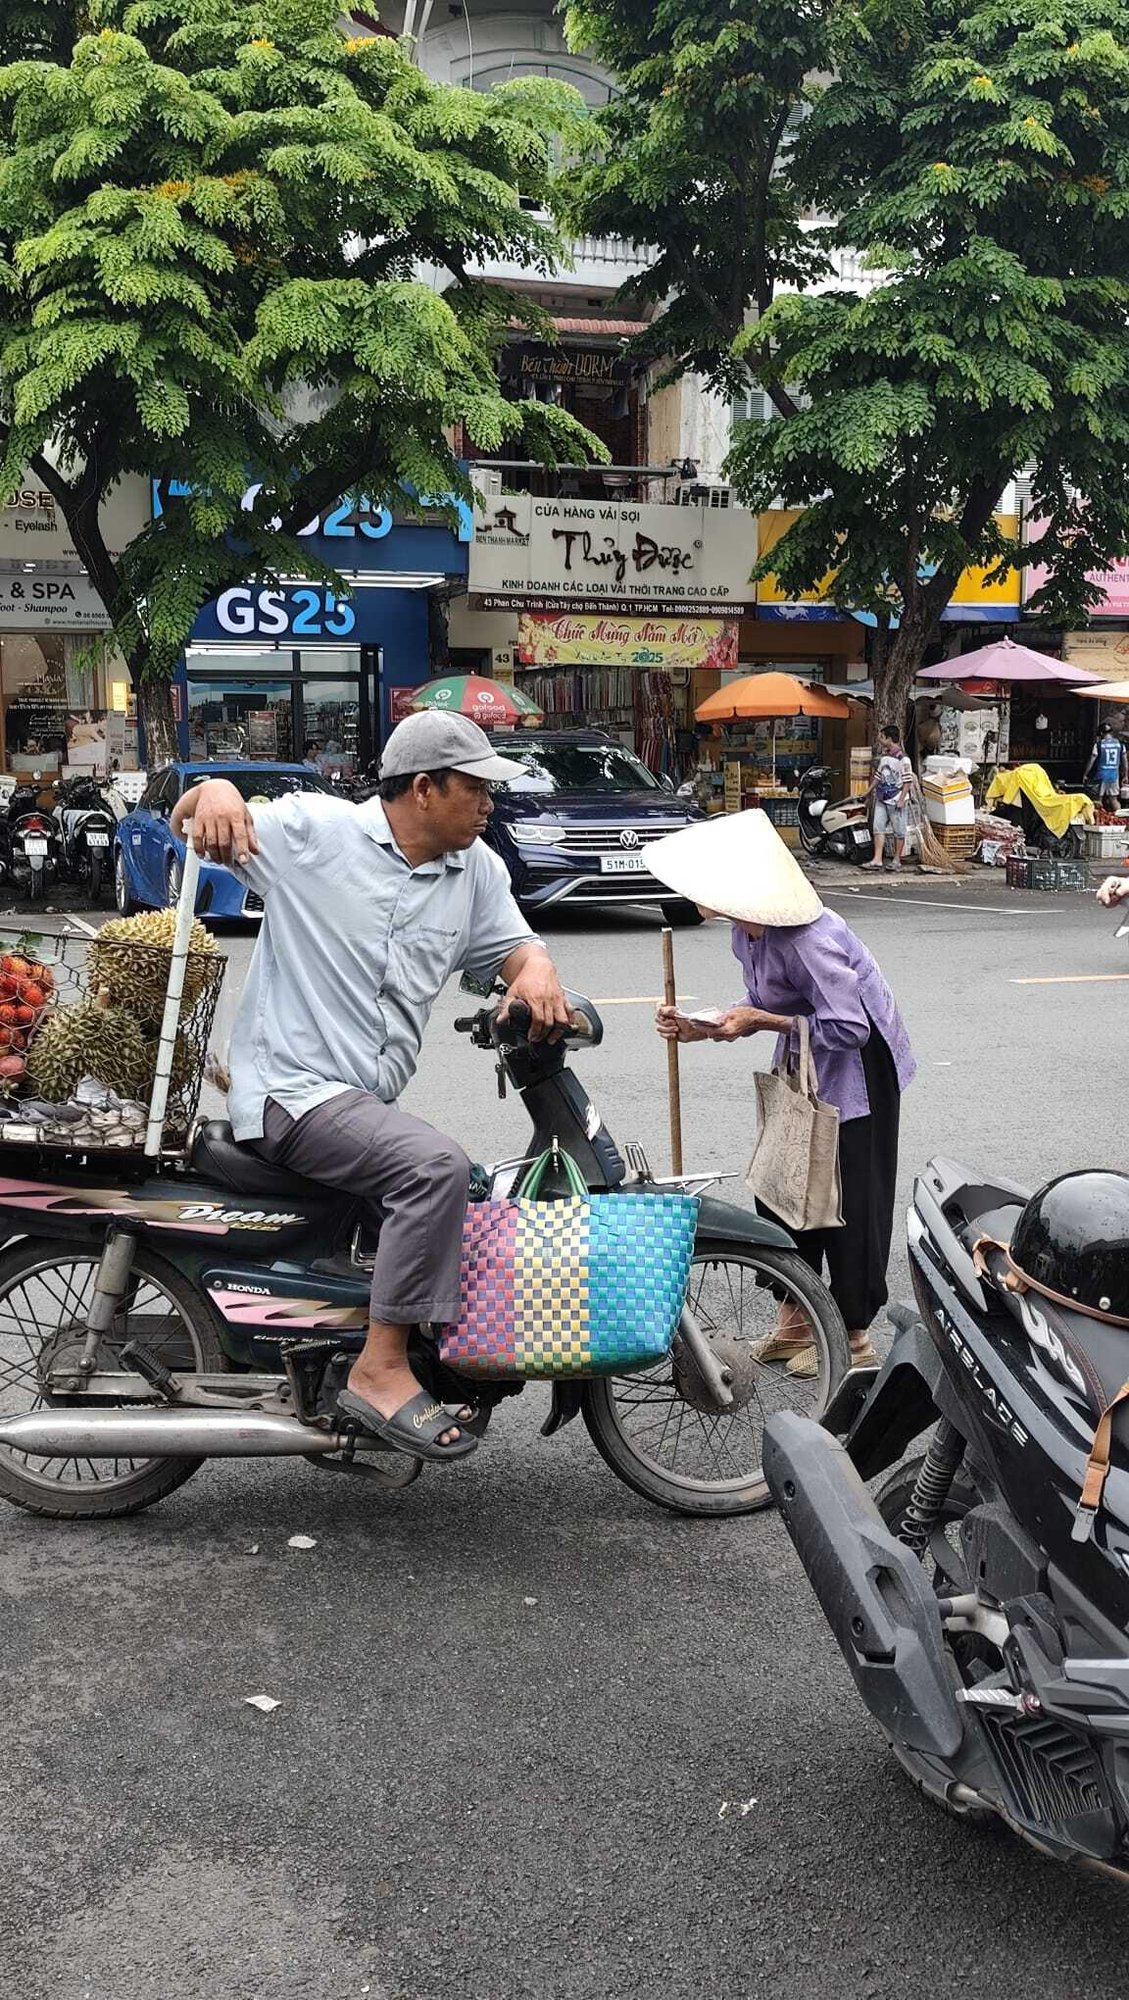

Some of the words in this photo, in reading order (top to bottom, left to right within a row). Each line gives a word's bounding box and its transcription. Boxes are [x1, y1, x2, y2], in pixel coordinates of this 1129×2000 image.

[241, 483, 394, 539] 25
[535, 503, 559, 517] CỬA
[563, 505, 595, 519] HÀNG
[599, 506, 617, 520] VẢI
[620, 510, 640, 524] SỢI
[15, 520, 58, 533] Eyelash
[552, 528, 628, 582] Thủy
[632, 531, 694, 575] Được
[10, 582, 25, 598] &
[32, 582, 76, 600] SPA
[502, 580, 524, 589] KINH
[526, 580, 560, 591] DOANH
[563, 581, 583, 592] CÁC
[586, 583, 608, 595] LOẠI
[610, 583, 626, 595] VẢI
[629, 583, 651, 595] THỜI
[653, 585, 685, 597] TRANG
[687, 587, 707, 597] CAO
[710, 585, 730, 597] CẤP
[0, 602, 15, 613] oot
[24, 603, 68, 616] Shampoo
[217, 588, 355, 635] GS25
[484, 598, 492, 607] 43
[493, 598, 510, 608] Phan
[621, 604, 633, 613] Q.1
[551, 619, 585, 644] Chúc
[588, 620, 632, 647] Mừng
[633, 622, 667, 644] Năm
[669, 623, 703, 646] Mới
[495, 653, 510, 664] 43
[630, 647, 664, 664] 2025
[1105, 748, 1118, 765] 13
[178, 1204, 306, 1225] Dream
[227, 1283, 272, 1296] HONDA
